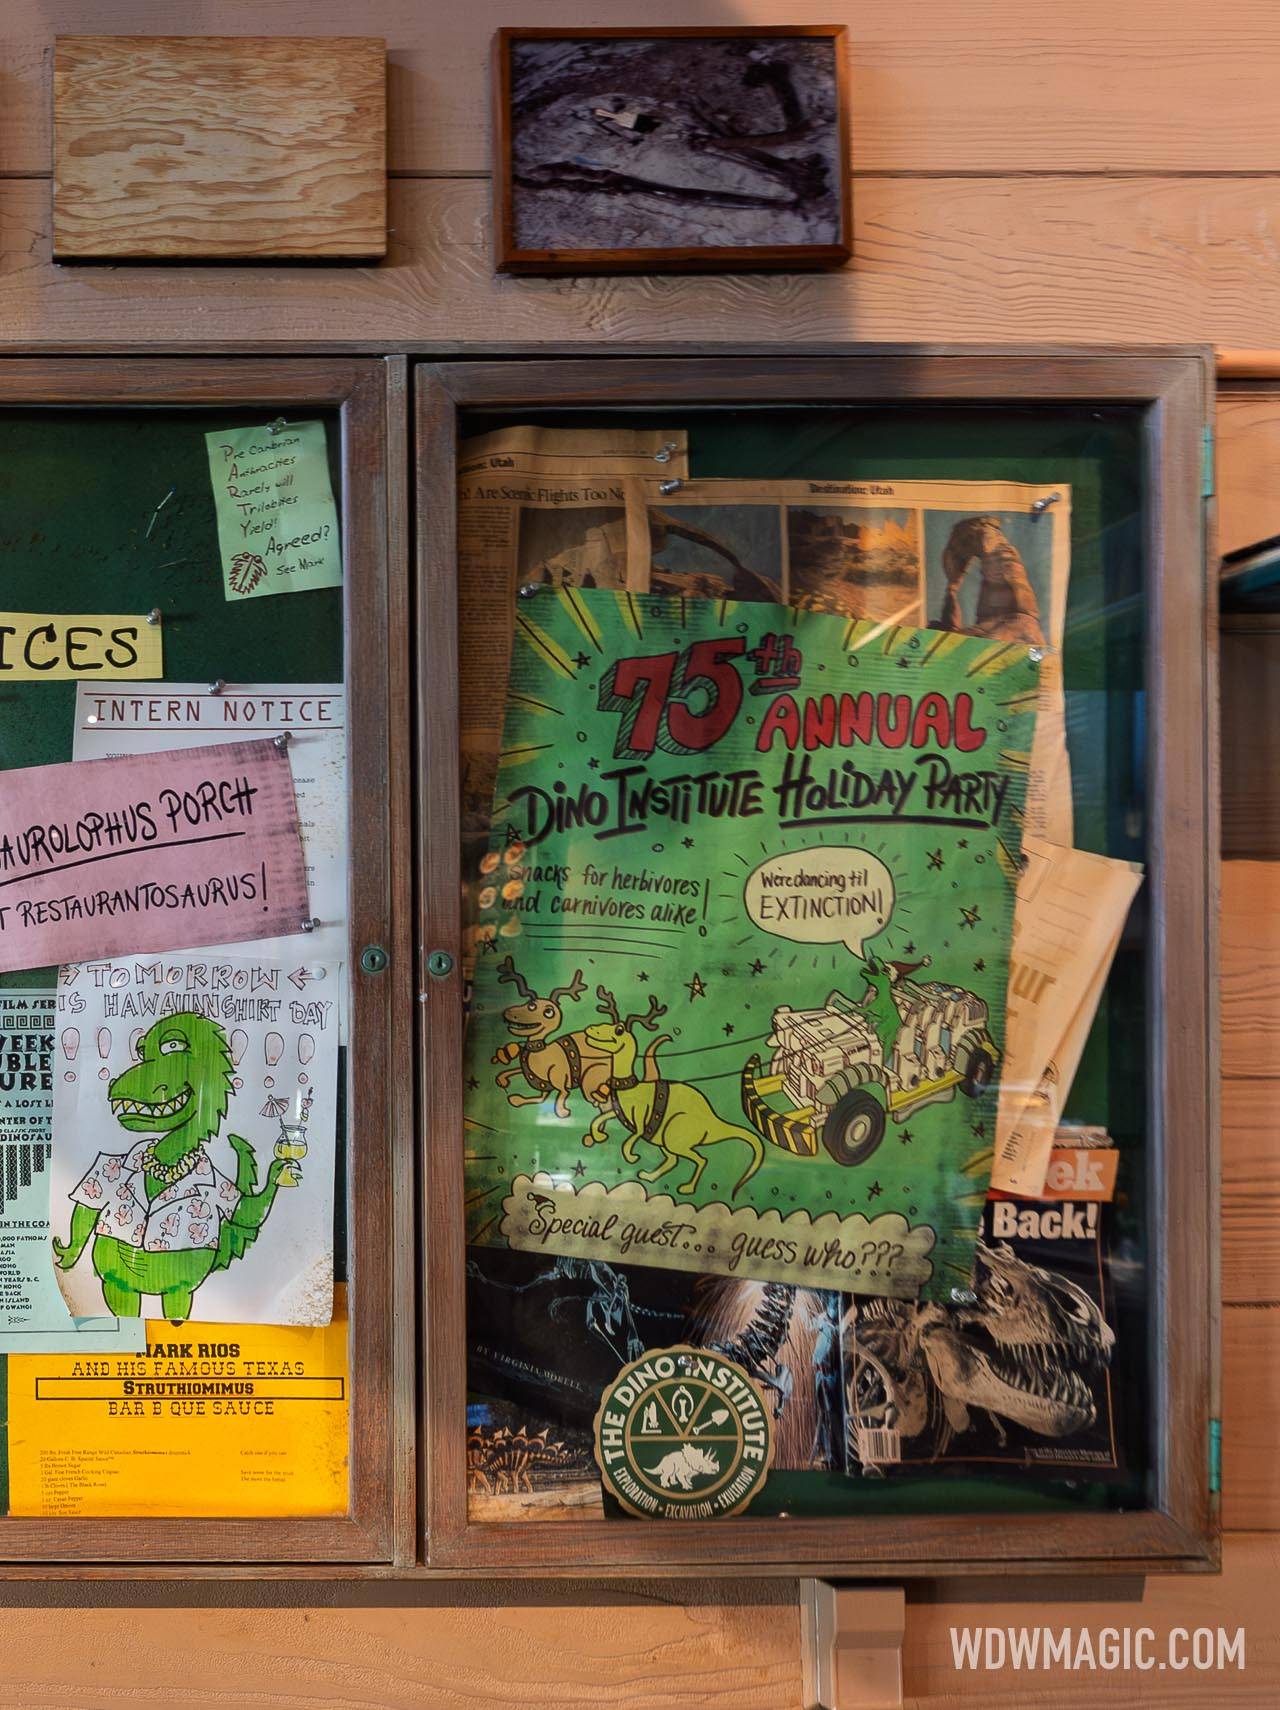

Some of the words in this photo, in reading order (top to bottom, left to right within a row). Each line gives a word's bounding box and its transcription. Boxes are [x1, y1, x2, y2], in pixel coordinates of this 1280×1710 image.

[275, 475, 295, 489] will
[265, 525, 331, 556] Agreed?
[276, 564, 296, 576] See
[94, 699, 200, 722] INTERN
[223, 700, 332, 722] NOTICE
[596, 632, 804, 763] 75th
[756, 691, 988, 753] ANNUAL
[160, 776, 258, 834] PORCH
[914, 752, 1010, 828] PARTY
[581, 863, 610, 887] for
[793, 867, 847, 893] dancing
[16, 860, 271, 926] RESTAURANTOSAURUS!
[550, 894, 646, 921] carnivores
[759, 886, 884, 926] EXTINCTION!
[58, 991, 87, 1014] IS
[222, 995, 281, 1023] SHIRT
[288, 1000, 333, 1031] DAY
[4, 1100, 14, 1109] A
[15, 1100, 44, 1109] LOST
[29, 1116, 46, 1125] OF
[992, 1201, 1099, 1241] Back!
[527, 1204, 619, 1241] Special
[729, 1232, 798, 1271] guess
[803, 1238, 905, 1277] who???
[198, 1343, 241, 1358] RIOS
[71, 1361, 111, 1377] AND
[116, 1361, 148, 1377] HIS
[153, 1361, 237, 1377] FAMOUS
[243, 1360, 306, 1376] TEXAS
[613, 1355, 676, 1409] DINO
[108, 1400, 146, 1416] BAR
[152, 1400, 163, 1416] B
[170, 1400, 207, 1416] QUE
[212, 1400, 275, 1416] SAUCE
[601, 1410, 626, 1466] THE
[612, 1466, 661, 1513] EXPLORATION
[664, 1499, 714, 1521] EXCAVATION
[716, 1464, 757, 1509] EXULTATION
